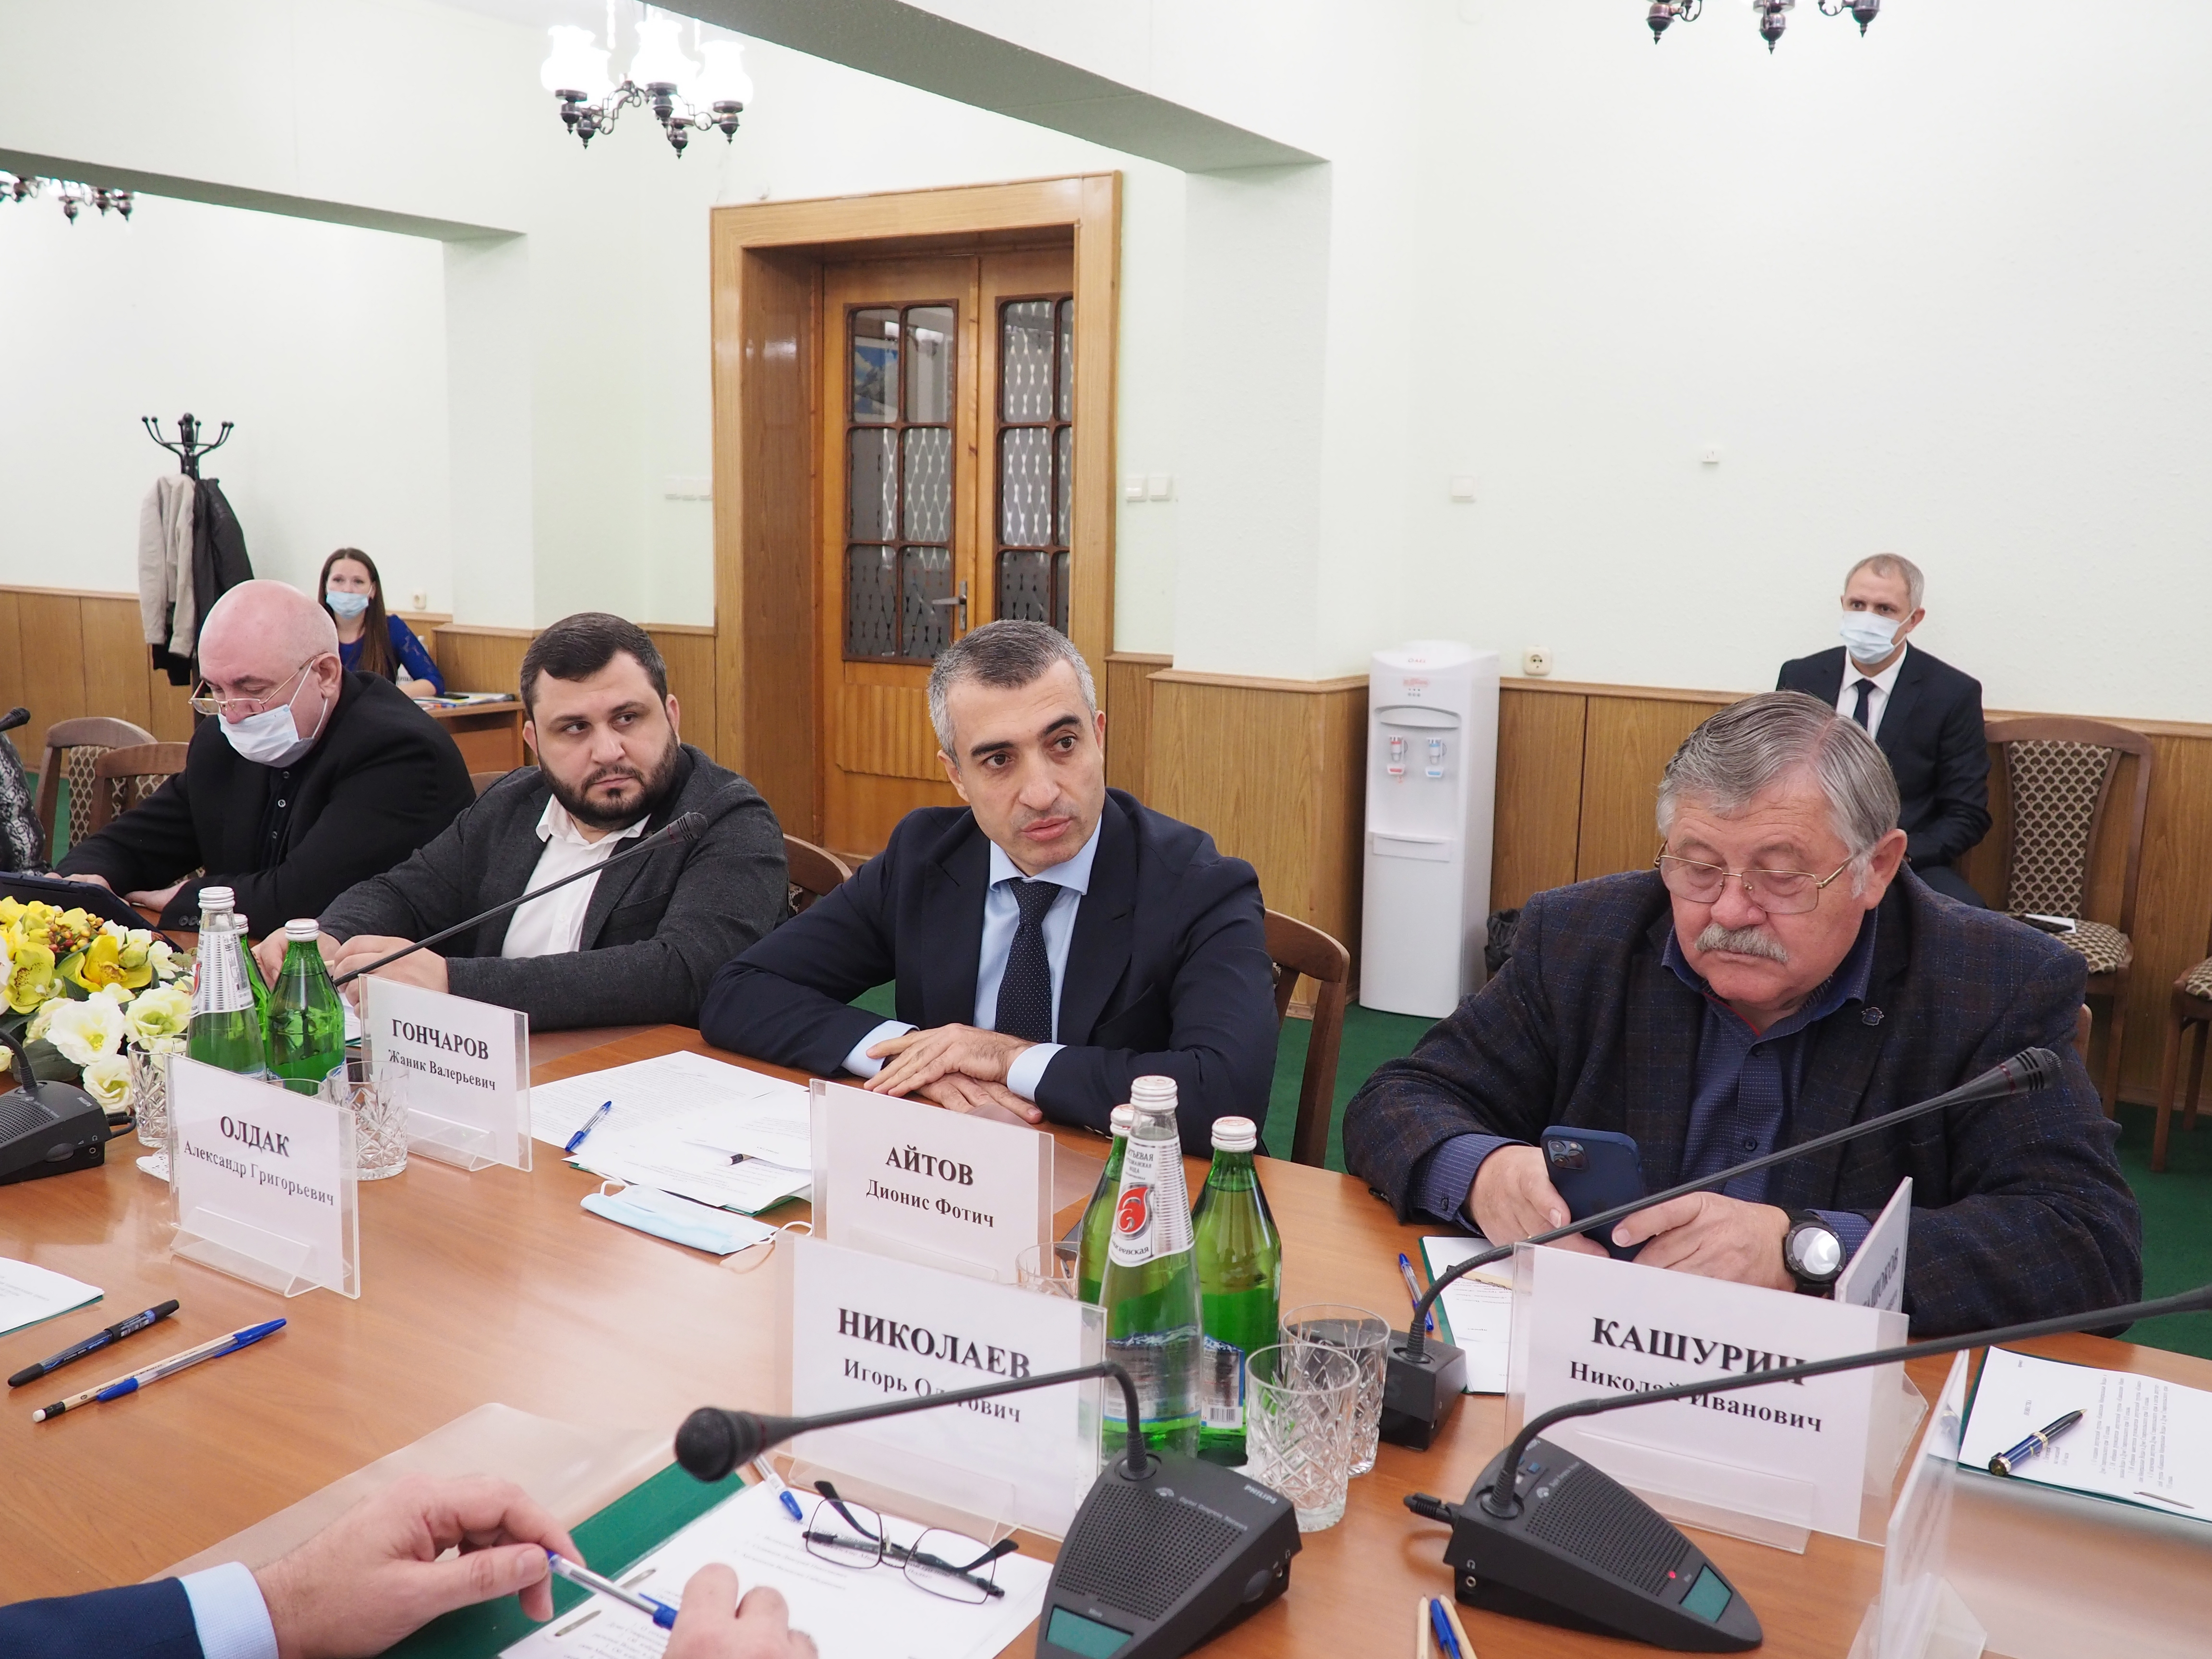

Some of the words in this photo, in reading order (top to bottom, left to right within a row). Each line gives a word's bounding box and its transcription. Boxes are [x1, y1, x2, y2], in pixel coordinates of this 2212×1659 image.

[392, 1018, 489, 1060] ГОНЧАРОВ
[388, 1049, 426, 1071] Жаник
[429, 1060, 496, 1091] Валерьевич
[220, 1116, 290, 1157] ОЛДАК
[184, 1140, 247, 1178] Александр
[251, 1163, 334, 1206] Григорьевич
[885, 1144, 974, 1186] АЙТОВ
[866, 1179, 930, 1211] Дионис
[935, 1198, 994, 1228] Фотич
[837, 1307, 1031, 1379] НИКОЛАЕВ
[843, 1358, 907, 1393] Игорь
[914, 1378, 1021, 1423] Оович
[1569, 1360, 1681, 1402] Никол
[1688, 1389, 1822, 1433] Иванович
[1244, 1484, 1277, 1504] PHILIPS
